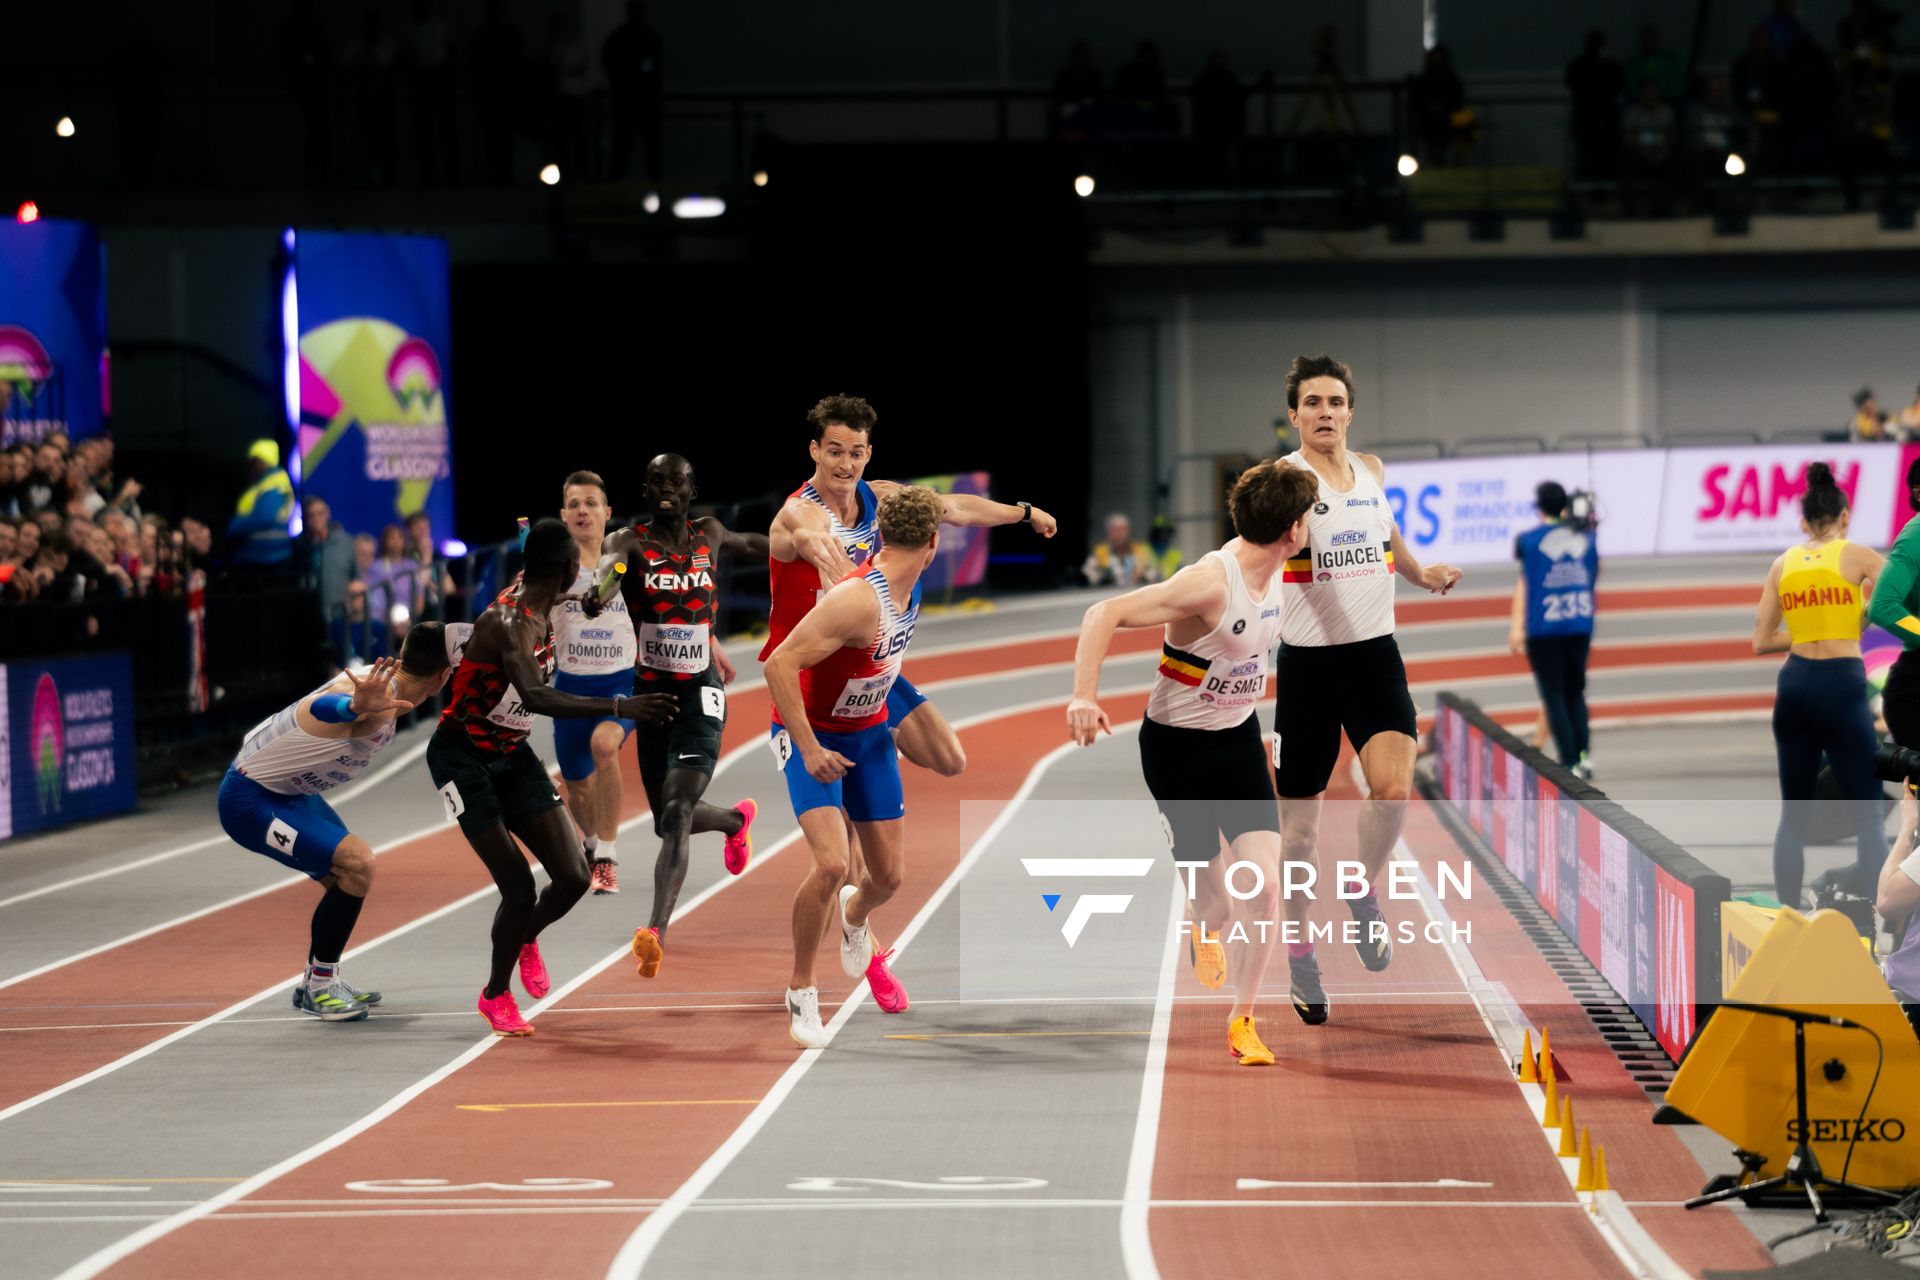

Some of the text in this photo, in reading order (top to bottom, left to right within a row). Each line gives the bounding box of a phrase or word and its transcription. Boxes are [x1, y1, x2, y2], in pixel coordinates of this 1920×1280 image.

[1331, 530, 1367, 546] HI-CHEW
[1317, 546, 1382, 569] IGUACEL
[644, 571, 713, 590] KENYA
[1334, 567, 1376, 580] GLASGOW
[1542, 592, 1592, 621] 235
[656, 628, 694, 641] HI-CHEW
[568, 642, 623, 658] DÖMÖTÖR
[645, 640, 703, 659] EKWAM
[656, 661, 696, 671] GLASGOW
[1206, 674, 1265, 695] DE SMET
[273, 830, 291, 847] 4
[1786, 1118, 1905, 1142] SEIKO
